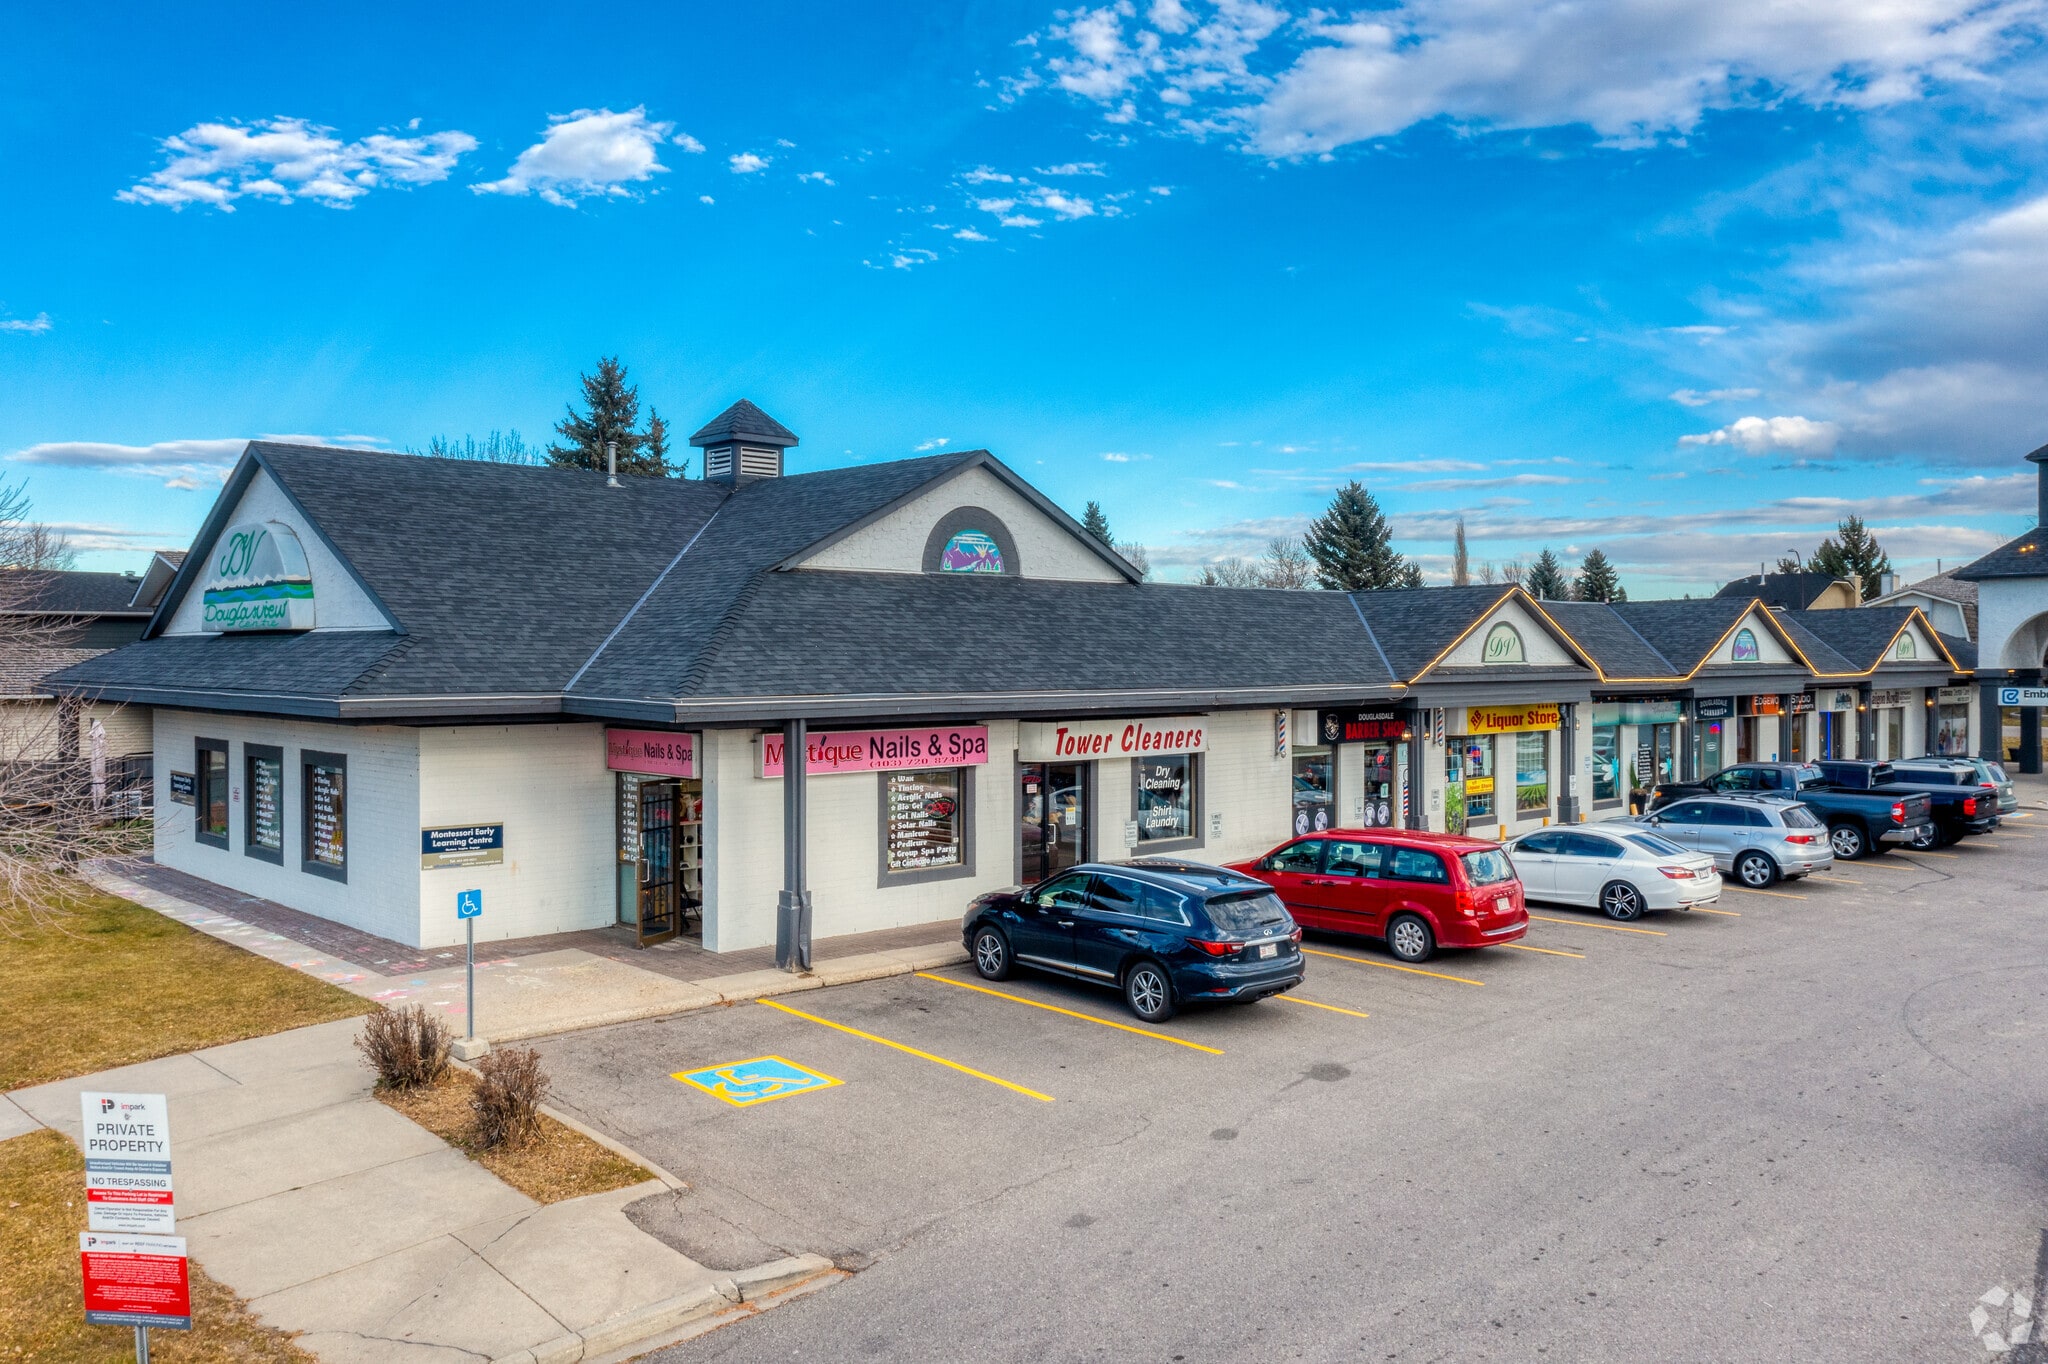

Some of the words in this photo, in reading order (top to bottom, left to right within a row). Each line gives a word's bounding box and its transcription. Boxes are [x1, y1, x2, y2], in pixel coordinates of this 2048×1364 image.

[1700, 699, 1728, 707] DOUGLASDALE
[1358, 712, 1394, 720] DOUGLASDALE
[1704, 708, 1724, 716] CANNABIS
[1486, 713, 1525, 730] Liquor
[1527, 711, 1558, 725] Store
[1345, 722, 1380, 740] BARBER
[1382, 720, 1406, 738] SHOP
[1056, 727, 1113, 756] Tower
[1121, 723, 1202, 752] Cleaners
[644, 742, 665, 759] Nails
[667, 743, 674, 759] &
[676, 744, 693, 765] Spa
[765, 735, 863, 768] Mtique
[869, 735, 921, 760] Nails
[927, 733, 943, 756] &
[948, 732, 986, 760] Spa
[1155, 765, 1170, 779] Dry
[898, 784, 924, 792] Tinting
[1145, 778, 1181, 790] Cleaning
[897, 794, 922, 802] Acrylic
[1152, 805, 1172, 816] Shirt
[1145, 815, 1179, 829] Laundry
[431, 829, 474, 839] Montessori
[475, 827, 495, 836] Early
[897, 831, 930, 839] Manicure
[432, 838, 467, 847] Learning
[897, 840, 927, 848] Pedicure
[921, 848, 934, 856] Spa
[937, 846, 957, 854] Party
[121, 1103, 144, 1111] impark
[97, 1123, 155, 1136] PRIVATE
[90, 1139, 163, 1152] PROPERTY
[92, 1177, 104, 1185] NO
[107, 1178, 167, 1187] TRESPASSING
